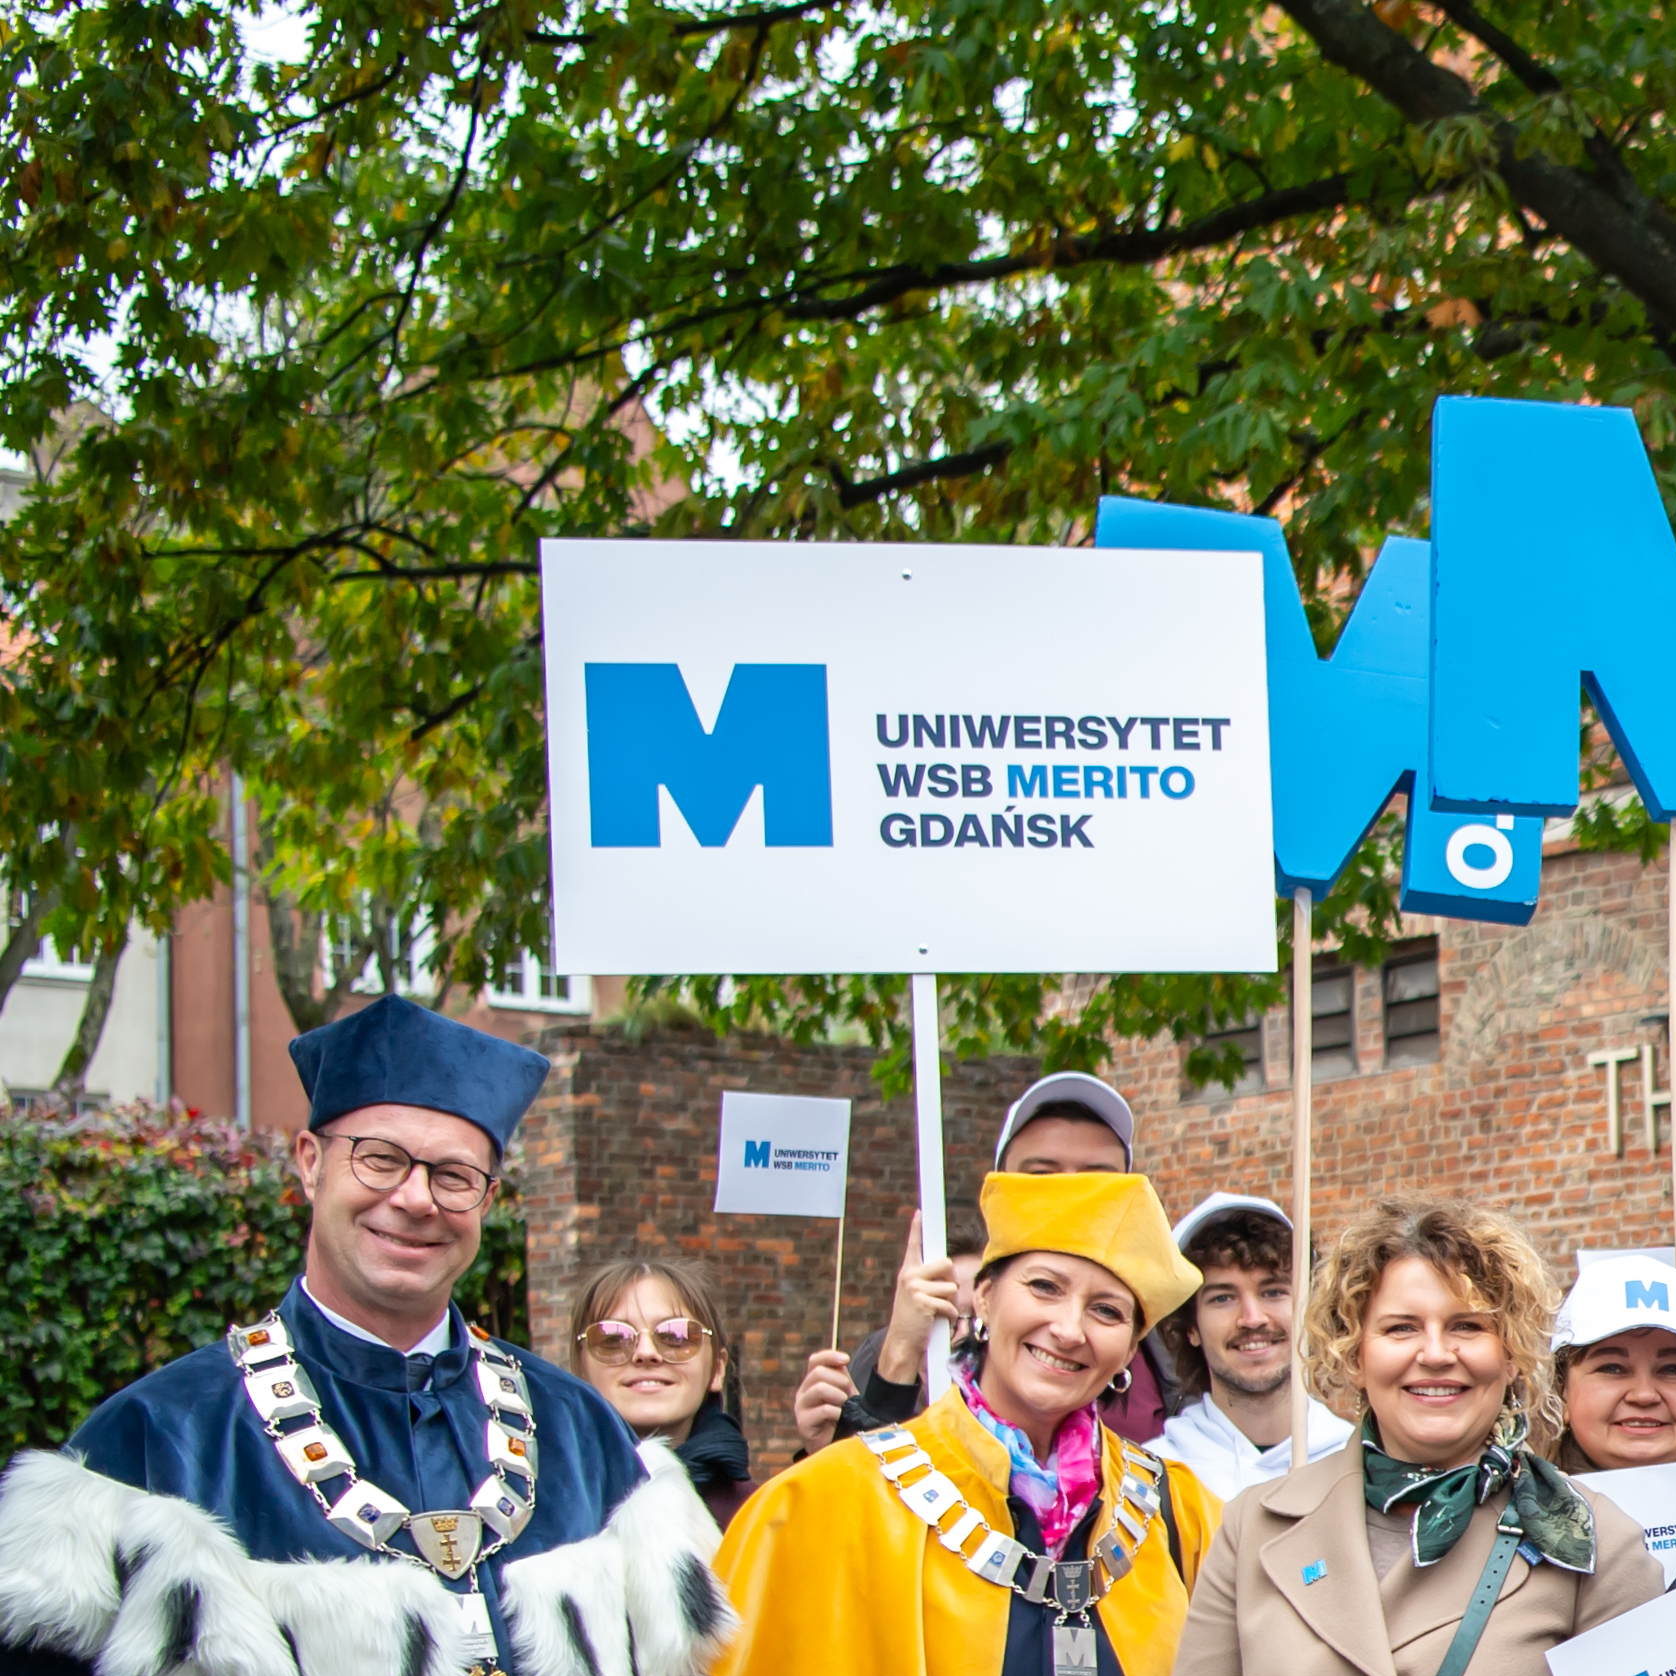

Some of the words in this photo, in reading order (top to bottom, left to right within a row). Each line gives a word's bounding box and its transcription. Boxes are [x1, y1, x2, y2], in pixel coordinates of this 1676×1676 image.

[876, 713, 1231, 751] UNIWERSYTET
[584, 662, 833, 848] M
[877, 763, 993, 798] WSB
[1007, 765, 1196, 800] MERITO
[879, 805, 1095, 849] GDAŃSK
[744, 1140, 771, 1168] M
[773, 1161, 793, 1170] WSB
[794, 1162, 830, 1172] MERITO
[774, 1149, 839, 1161] UNIWERSYTET
